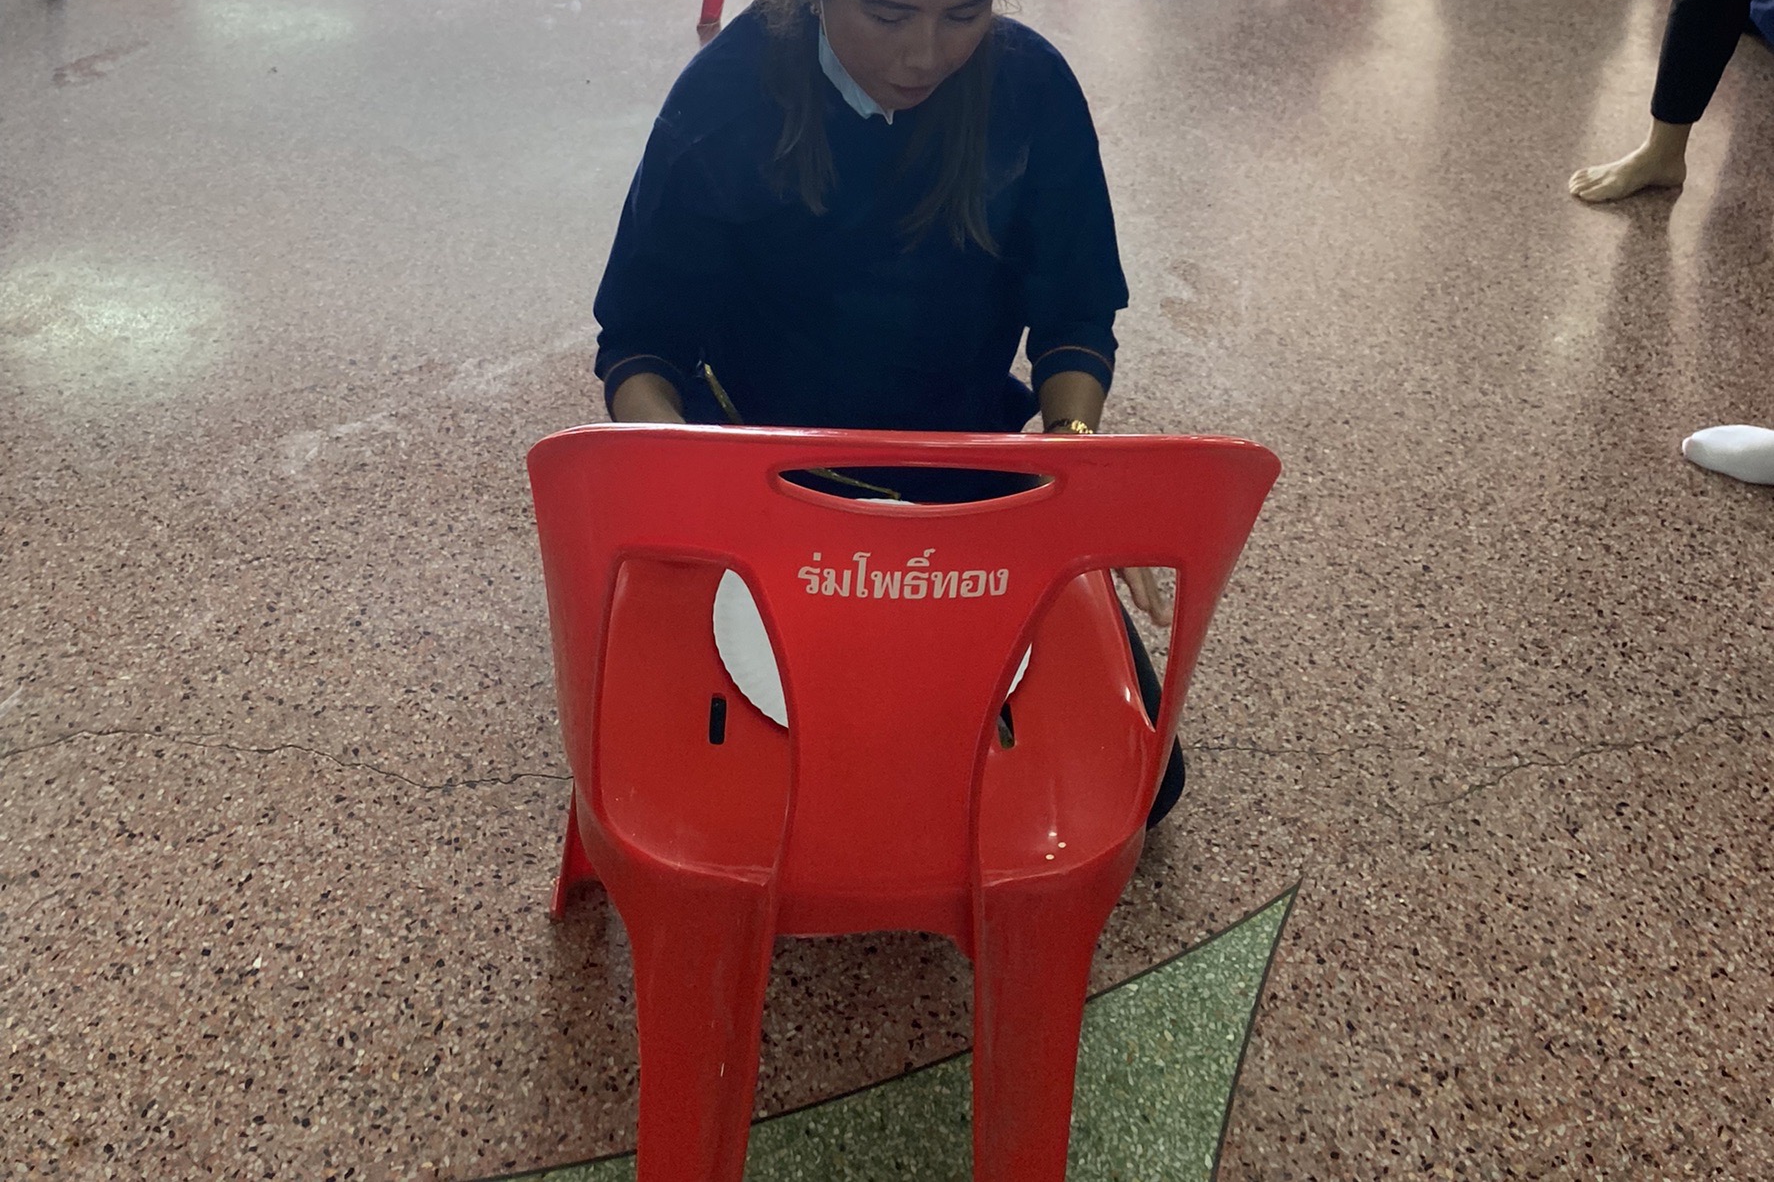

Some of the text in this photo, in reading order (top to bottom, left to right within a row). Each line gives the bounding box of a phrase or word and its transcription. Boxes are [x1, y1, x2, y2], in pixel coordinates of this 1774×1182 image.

[798, 548, 1009, 599] ร่มโพธิ์ทอง
